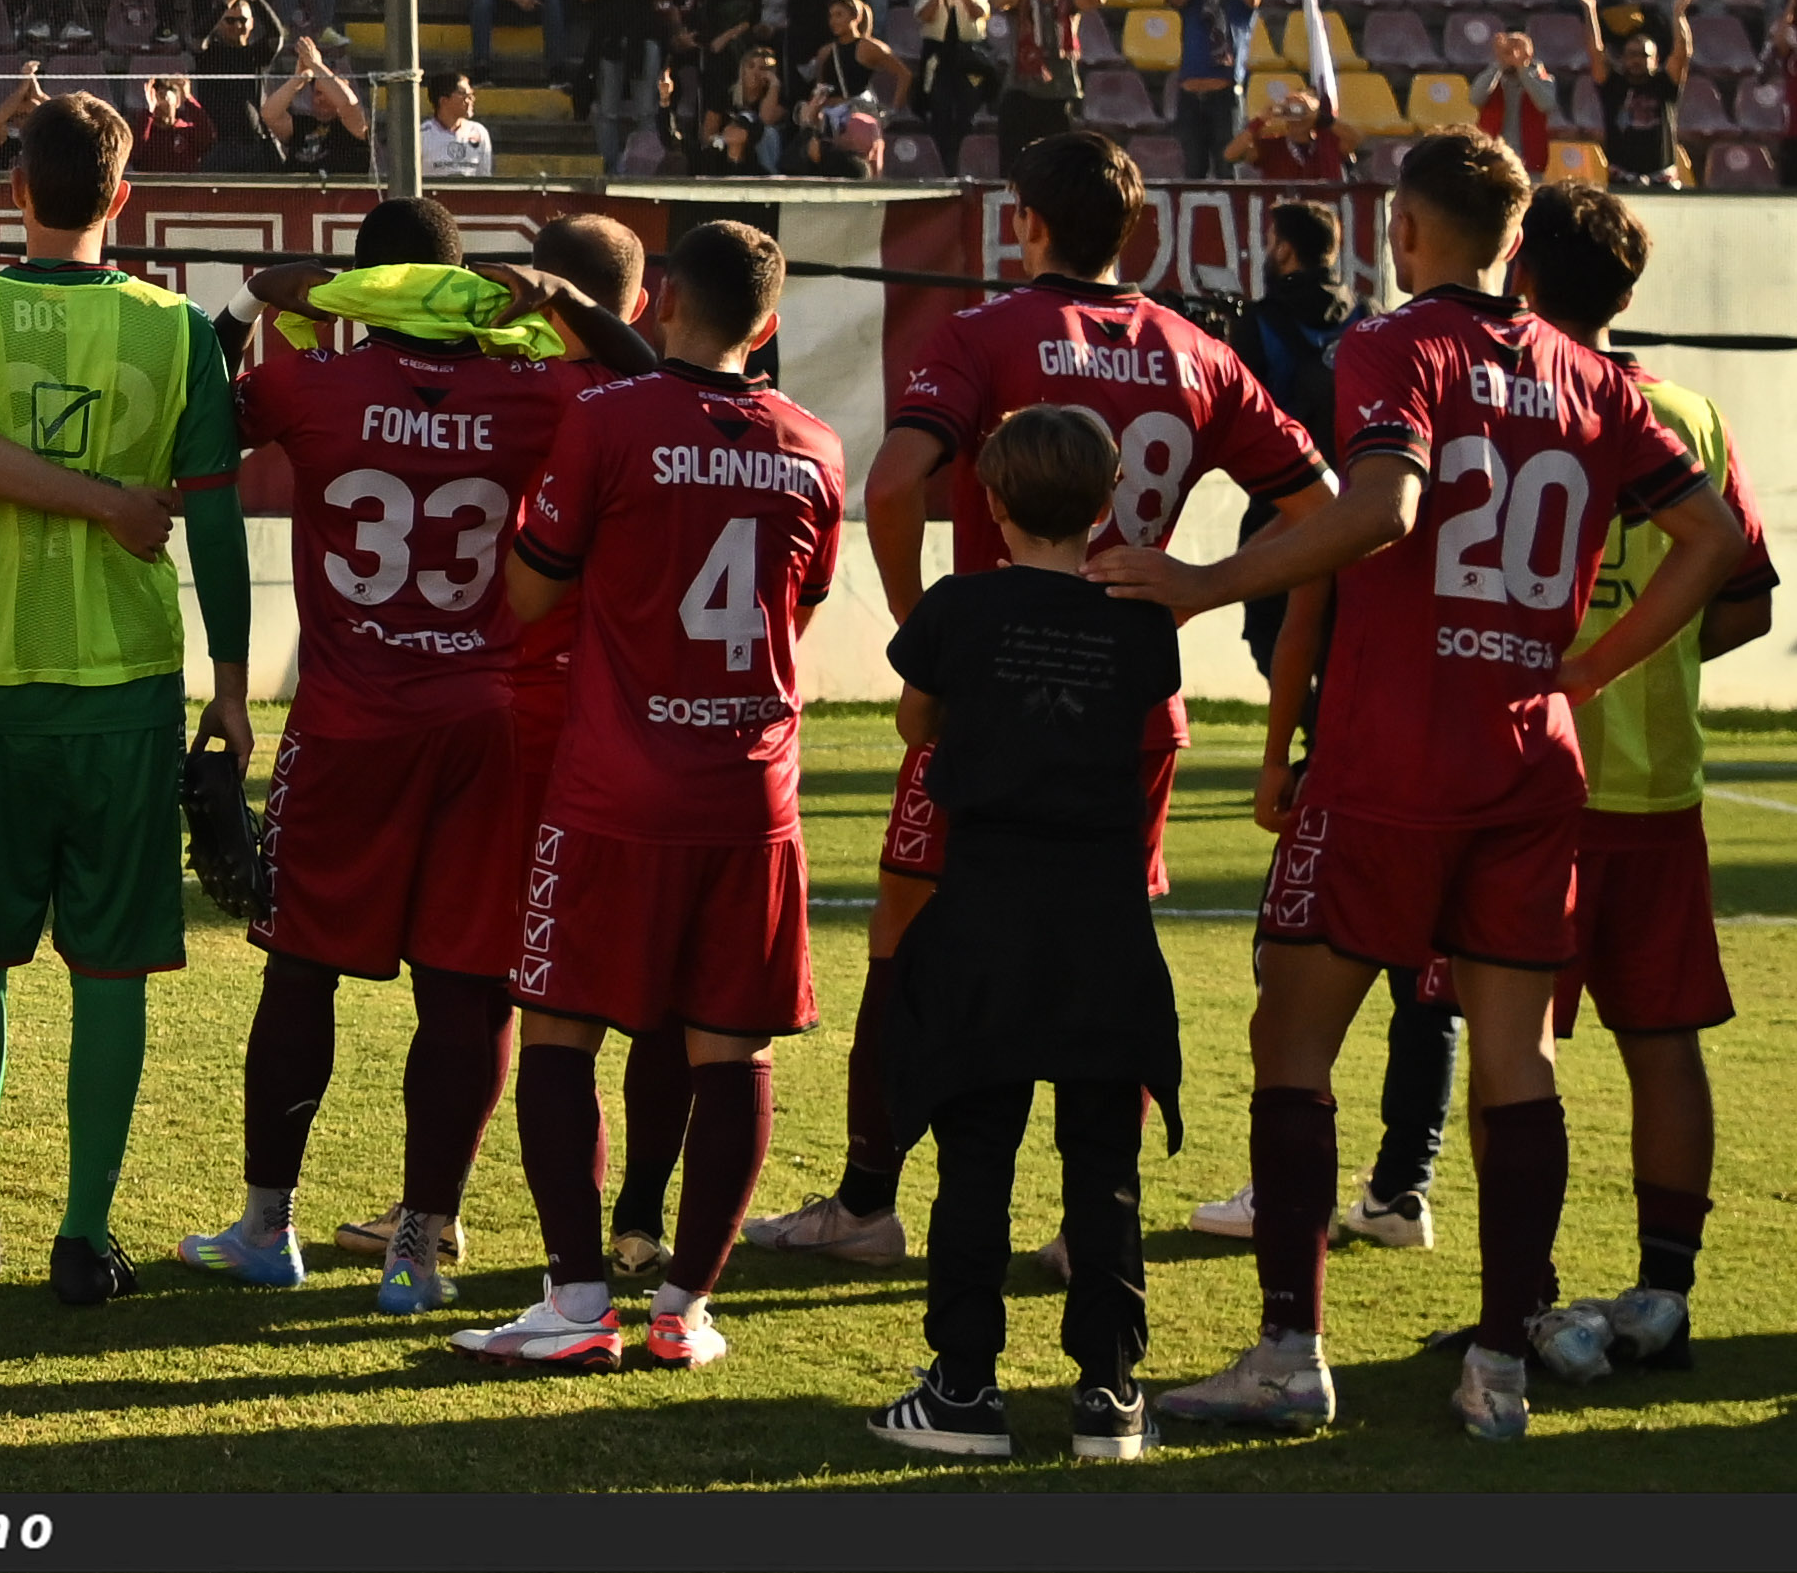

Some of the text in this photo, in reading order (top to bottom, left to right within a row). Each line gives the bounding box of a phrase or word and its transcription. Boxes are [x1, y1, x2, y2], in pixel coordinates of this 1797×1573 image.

[1037, 339, 1168, 387] GIRASOLE
[361, 404, 494, 452] FOMETE
[323, 467, 510, 612] 33
[1434, 434, 1591, 612] 20
[678, 516, 767, 672] 4
[647, 693, 780, 727] SOSETEG
